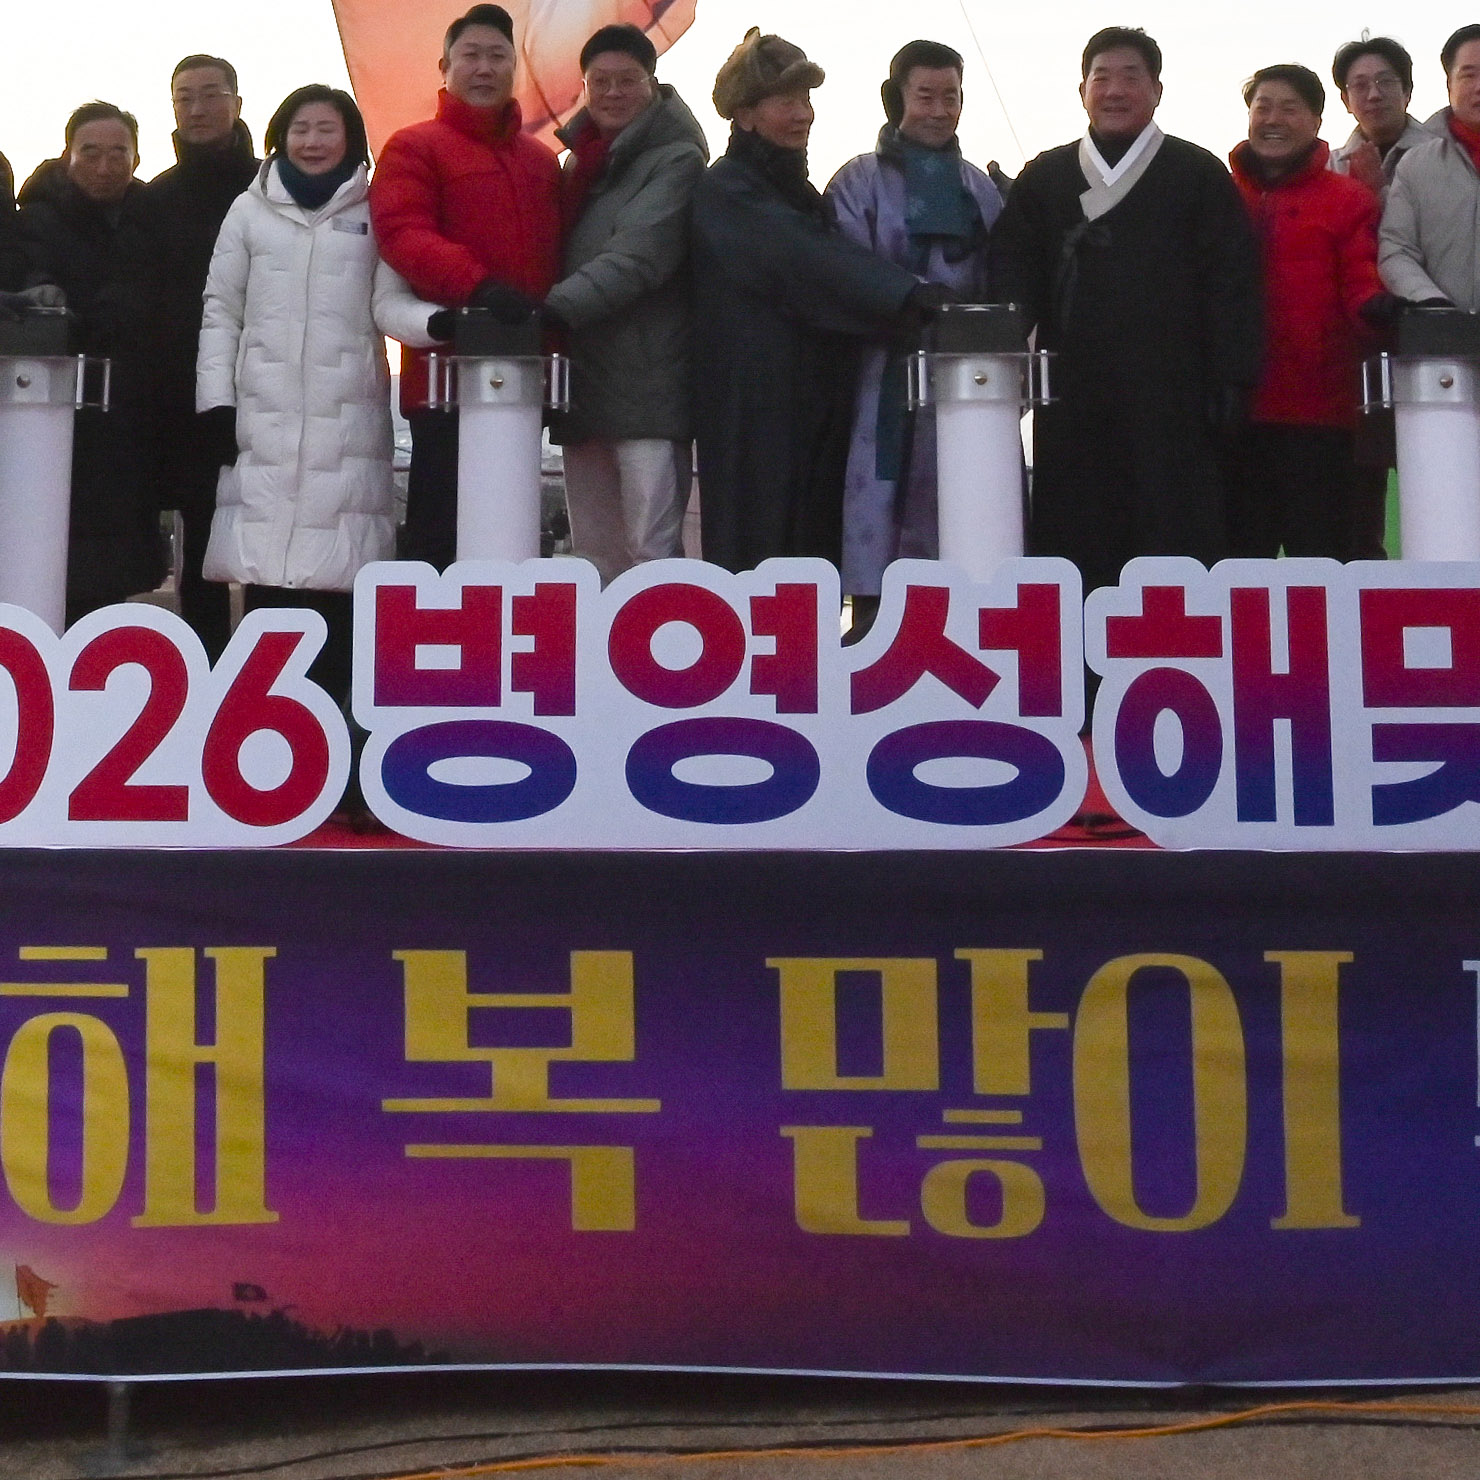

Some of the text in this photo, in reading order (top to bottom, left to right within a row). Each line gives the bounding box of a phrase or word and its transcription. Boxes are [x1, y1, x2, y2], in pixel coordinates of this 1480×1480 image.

[373, 581, 1066, 825] 병영성
[382, 948, 661, 1233] 복
[764, 947, 1362, 1240] 많이
